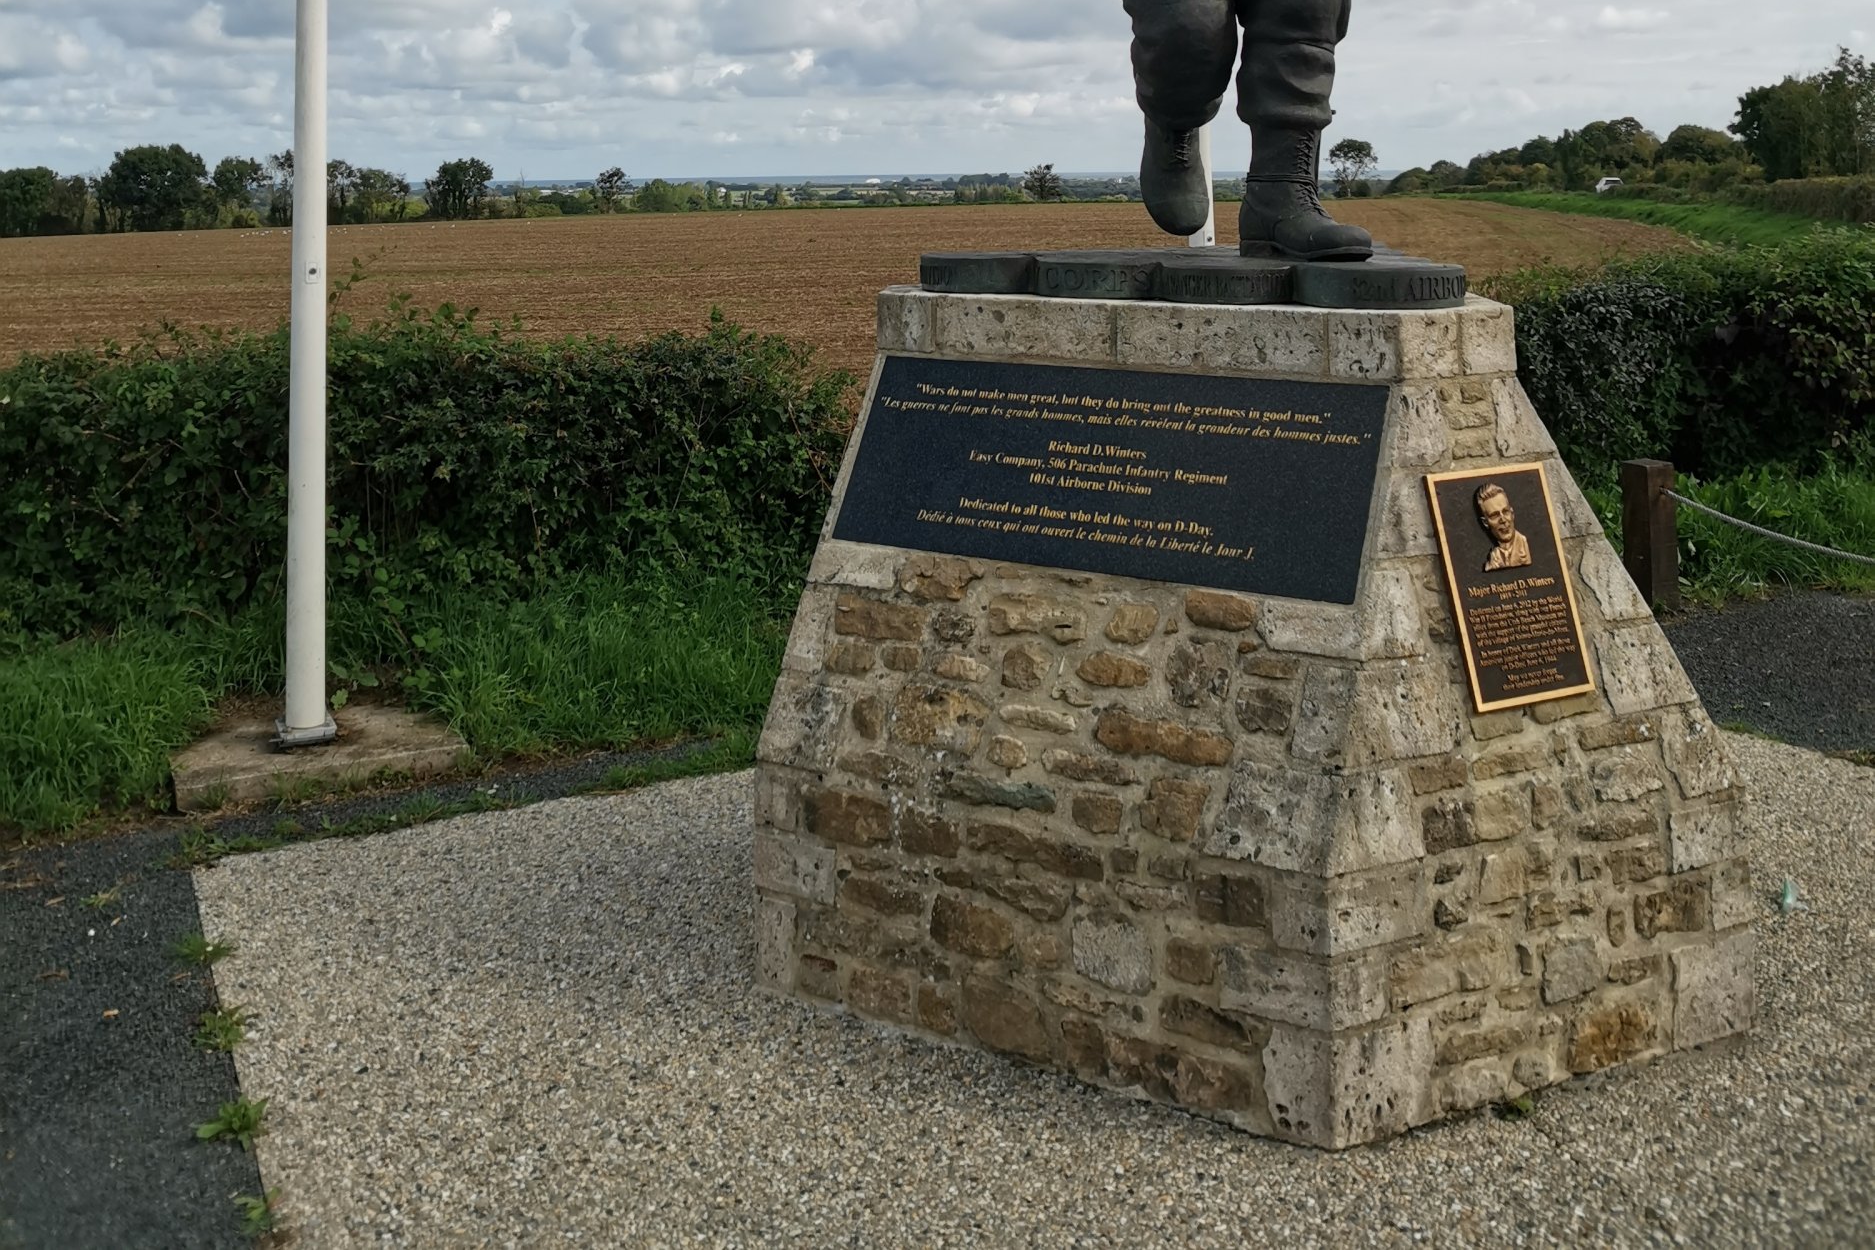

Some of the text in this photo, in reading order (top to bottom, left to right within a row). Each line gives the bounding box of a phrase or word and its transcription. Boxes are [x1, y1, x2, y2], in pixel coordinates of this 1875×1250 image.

[1045, 267, 1149, 292] CORPS
[916, 383, 1331, 424] "Wars do not make men great, but they do bring out the greatness in good men."
[881, 396, 901, 408] "Les
[900, 401, 936, 411] guerres
[950, 401, 972, 414] font
[970, 406, 989, 416] pas
[990, 404, 1004, 415] les
[1004, 407, 1040, 419] grands
[1041, 408, 1084, 424] hommes,
[1087, 413, 1113, 425] mais
[1114, 414, 1138, 427] elles
[1184, 419, 1197, 432] la
[1197, 423, 1251, 436] grandeur
[1251, 425, 1271, 438] des
[1273, 426, 1322, 442] hommes
[1048, 440, 1091, 455] Richard
[969, 450, 1228, 485] Easy Company, 506 Parachute Infantry Regiment
[1029, 473, 1152, 495] 101st Airborne Division
[959, 497, 1213, 538] Dedicated to all those who led the way on D-Day.
[954, 515, 976, 526] tous
[977, 519, 1002, 529] ceux
[1002, 520, 1022, 533] qui
[1021, 524, 1040, 534] ont
[1040, 526, 1075, 538] ouvert
[1075, 527, 1087, 540] le
[1088, 529, 1128, 544] chemin
[1129, 533, 1144, 546] de
[1145, 535, 1157, 548] la
[1159, 537, 1201, 553] Liberté
[1201, 541, 1213, 555] le
[1214, 543, 1243, 557] Jour
[1468, 577, 1554, 597] Major Richard D. Winters
[1515, 589, 1527, 597] 2011
[1520, 642, 1540, 650] Winters
